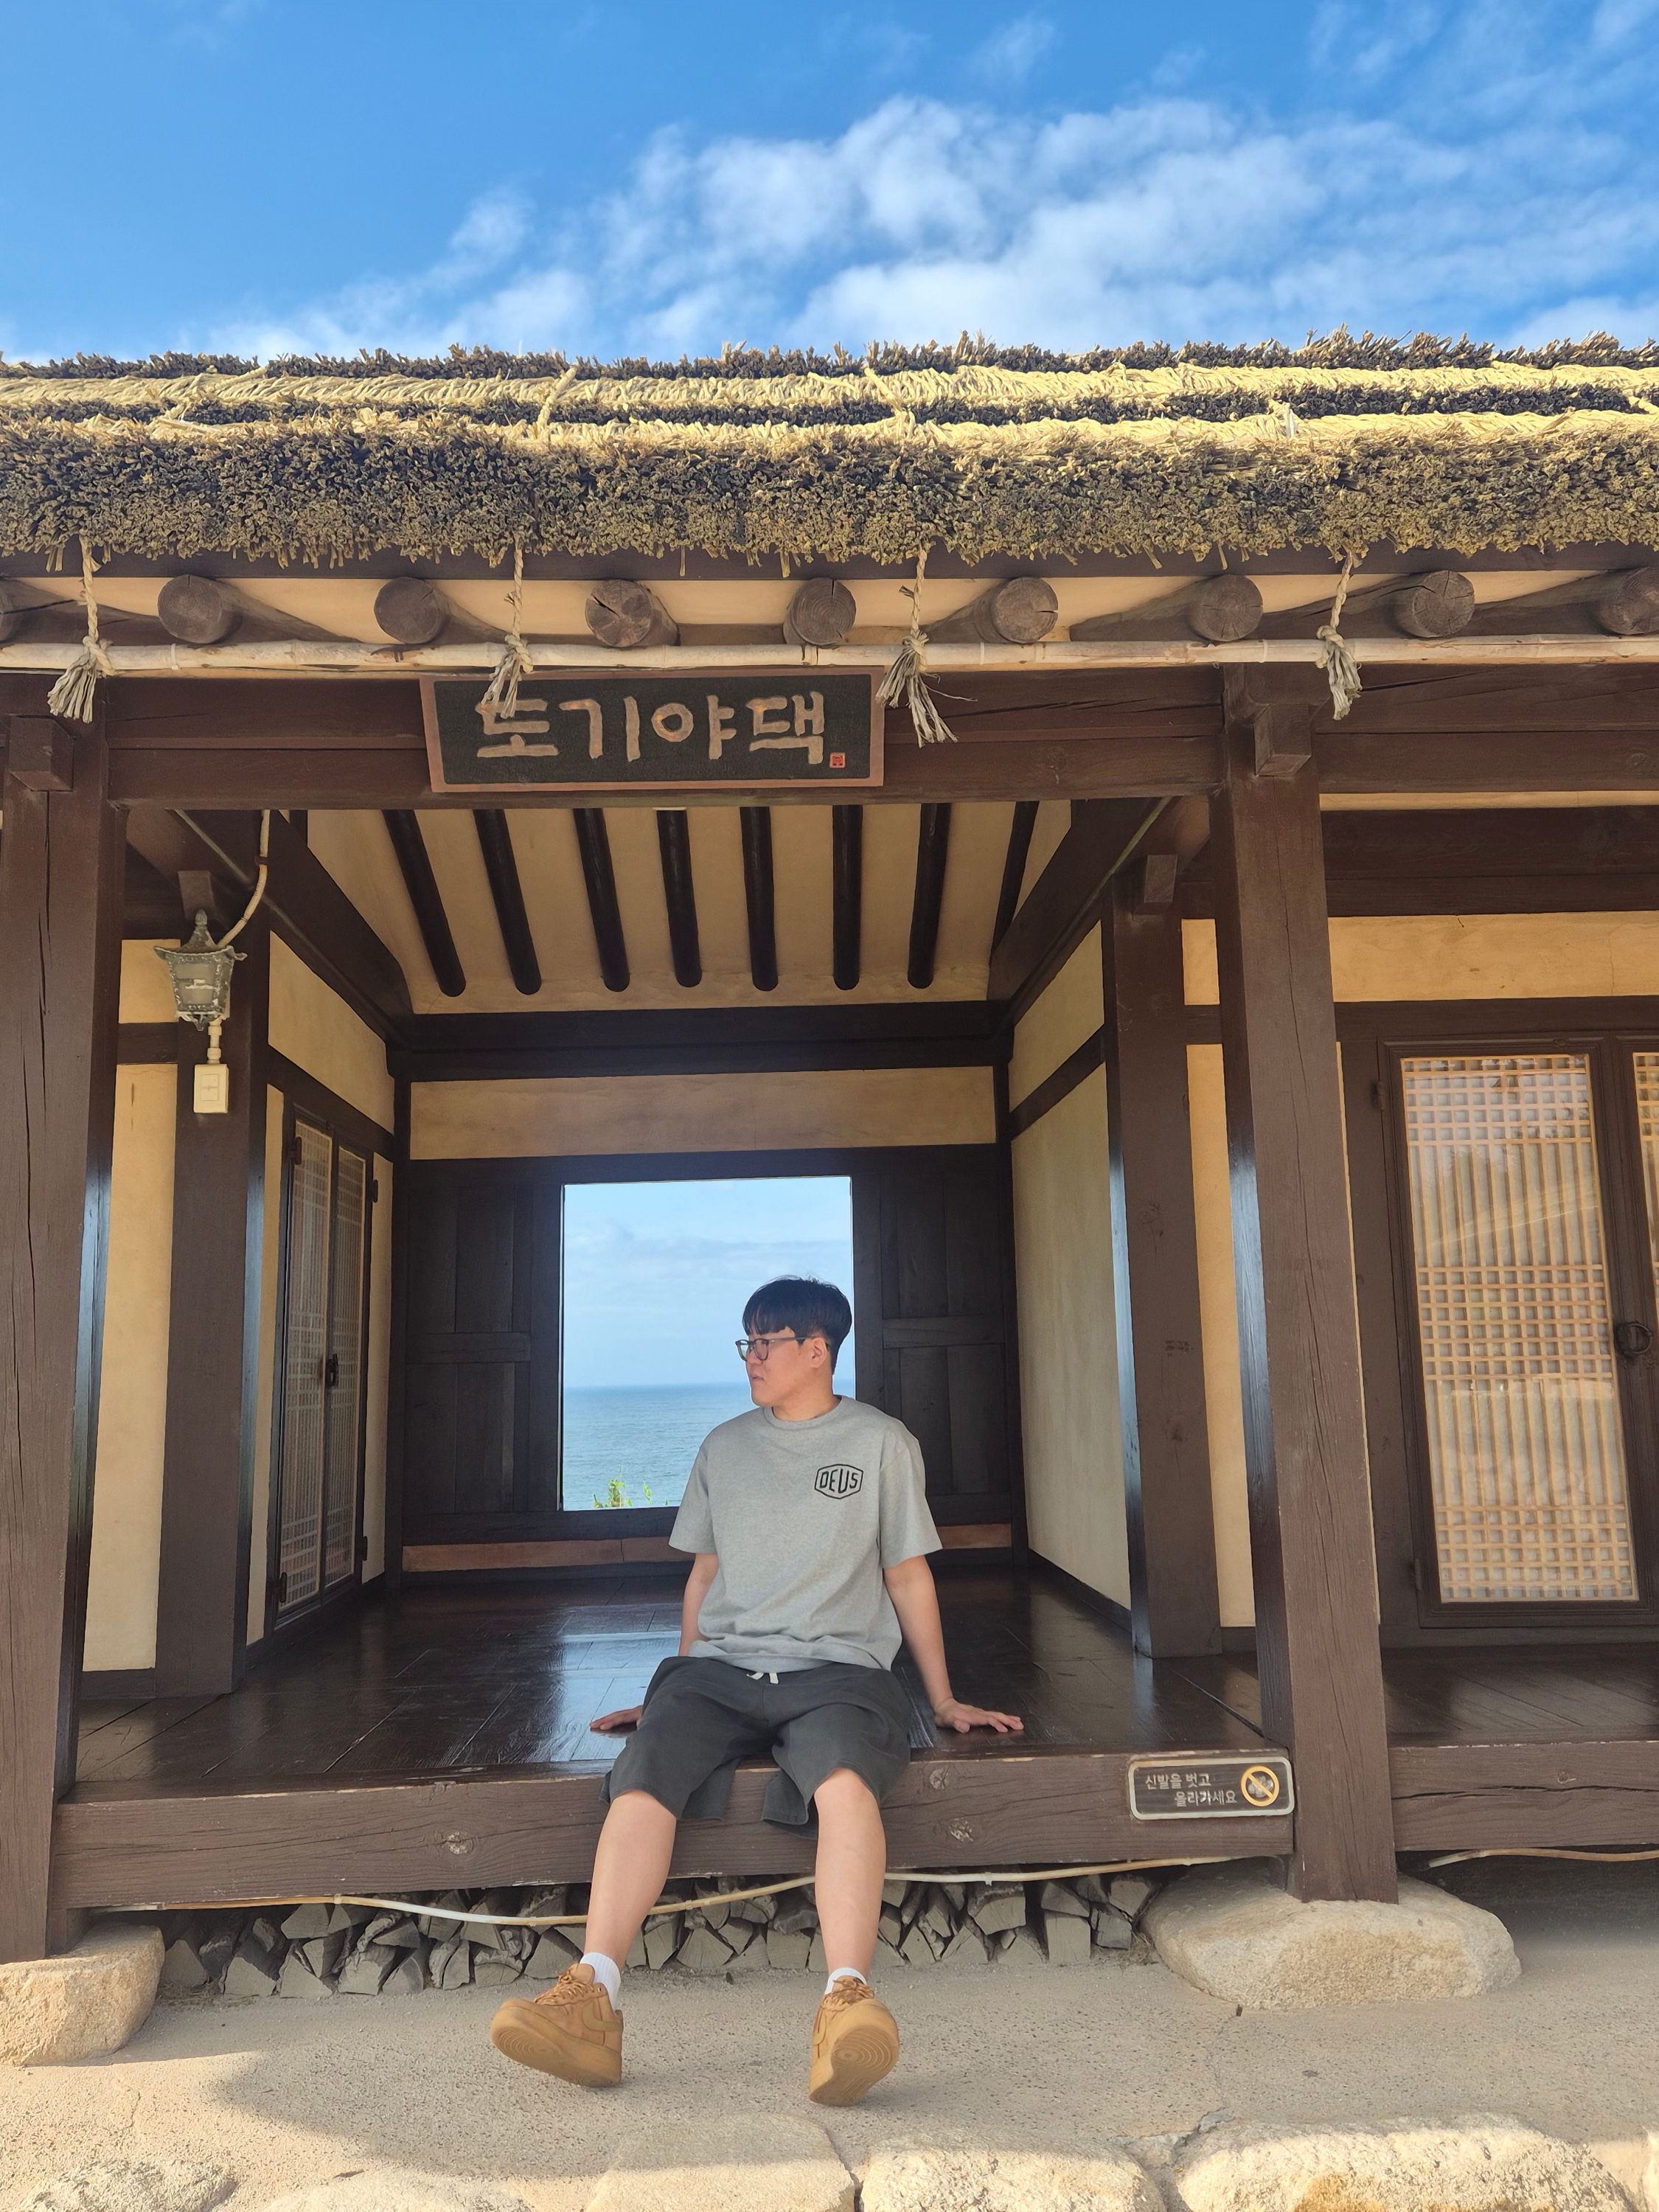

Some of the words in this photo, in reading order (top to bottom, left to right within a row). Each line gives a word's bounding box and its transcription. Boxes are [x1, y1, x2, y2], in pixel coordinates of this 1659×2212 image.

[475, 691, 824, 765] 도기야댁
[819, 1468, 858, 1494] DEUS
[1145, 1773, 1182, 1790] 신발을
[1185, 1773, 1211, 1789] 벗고
[1174, 1790, 1237, 1807] 올라가세요
